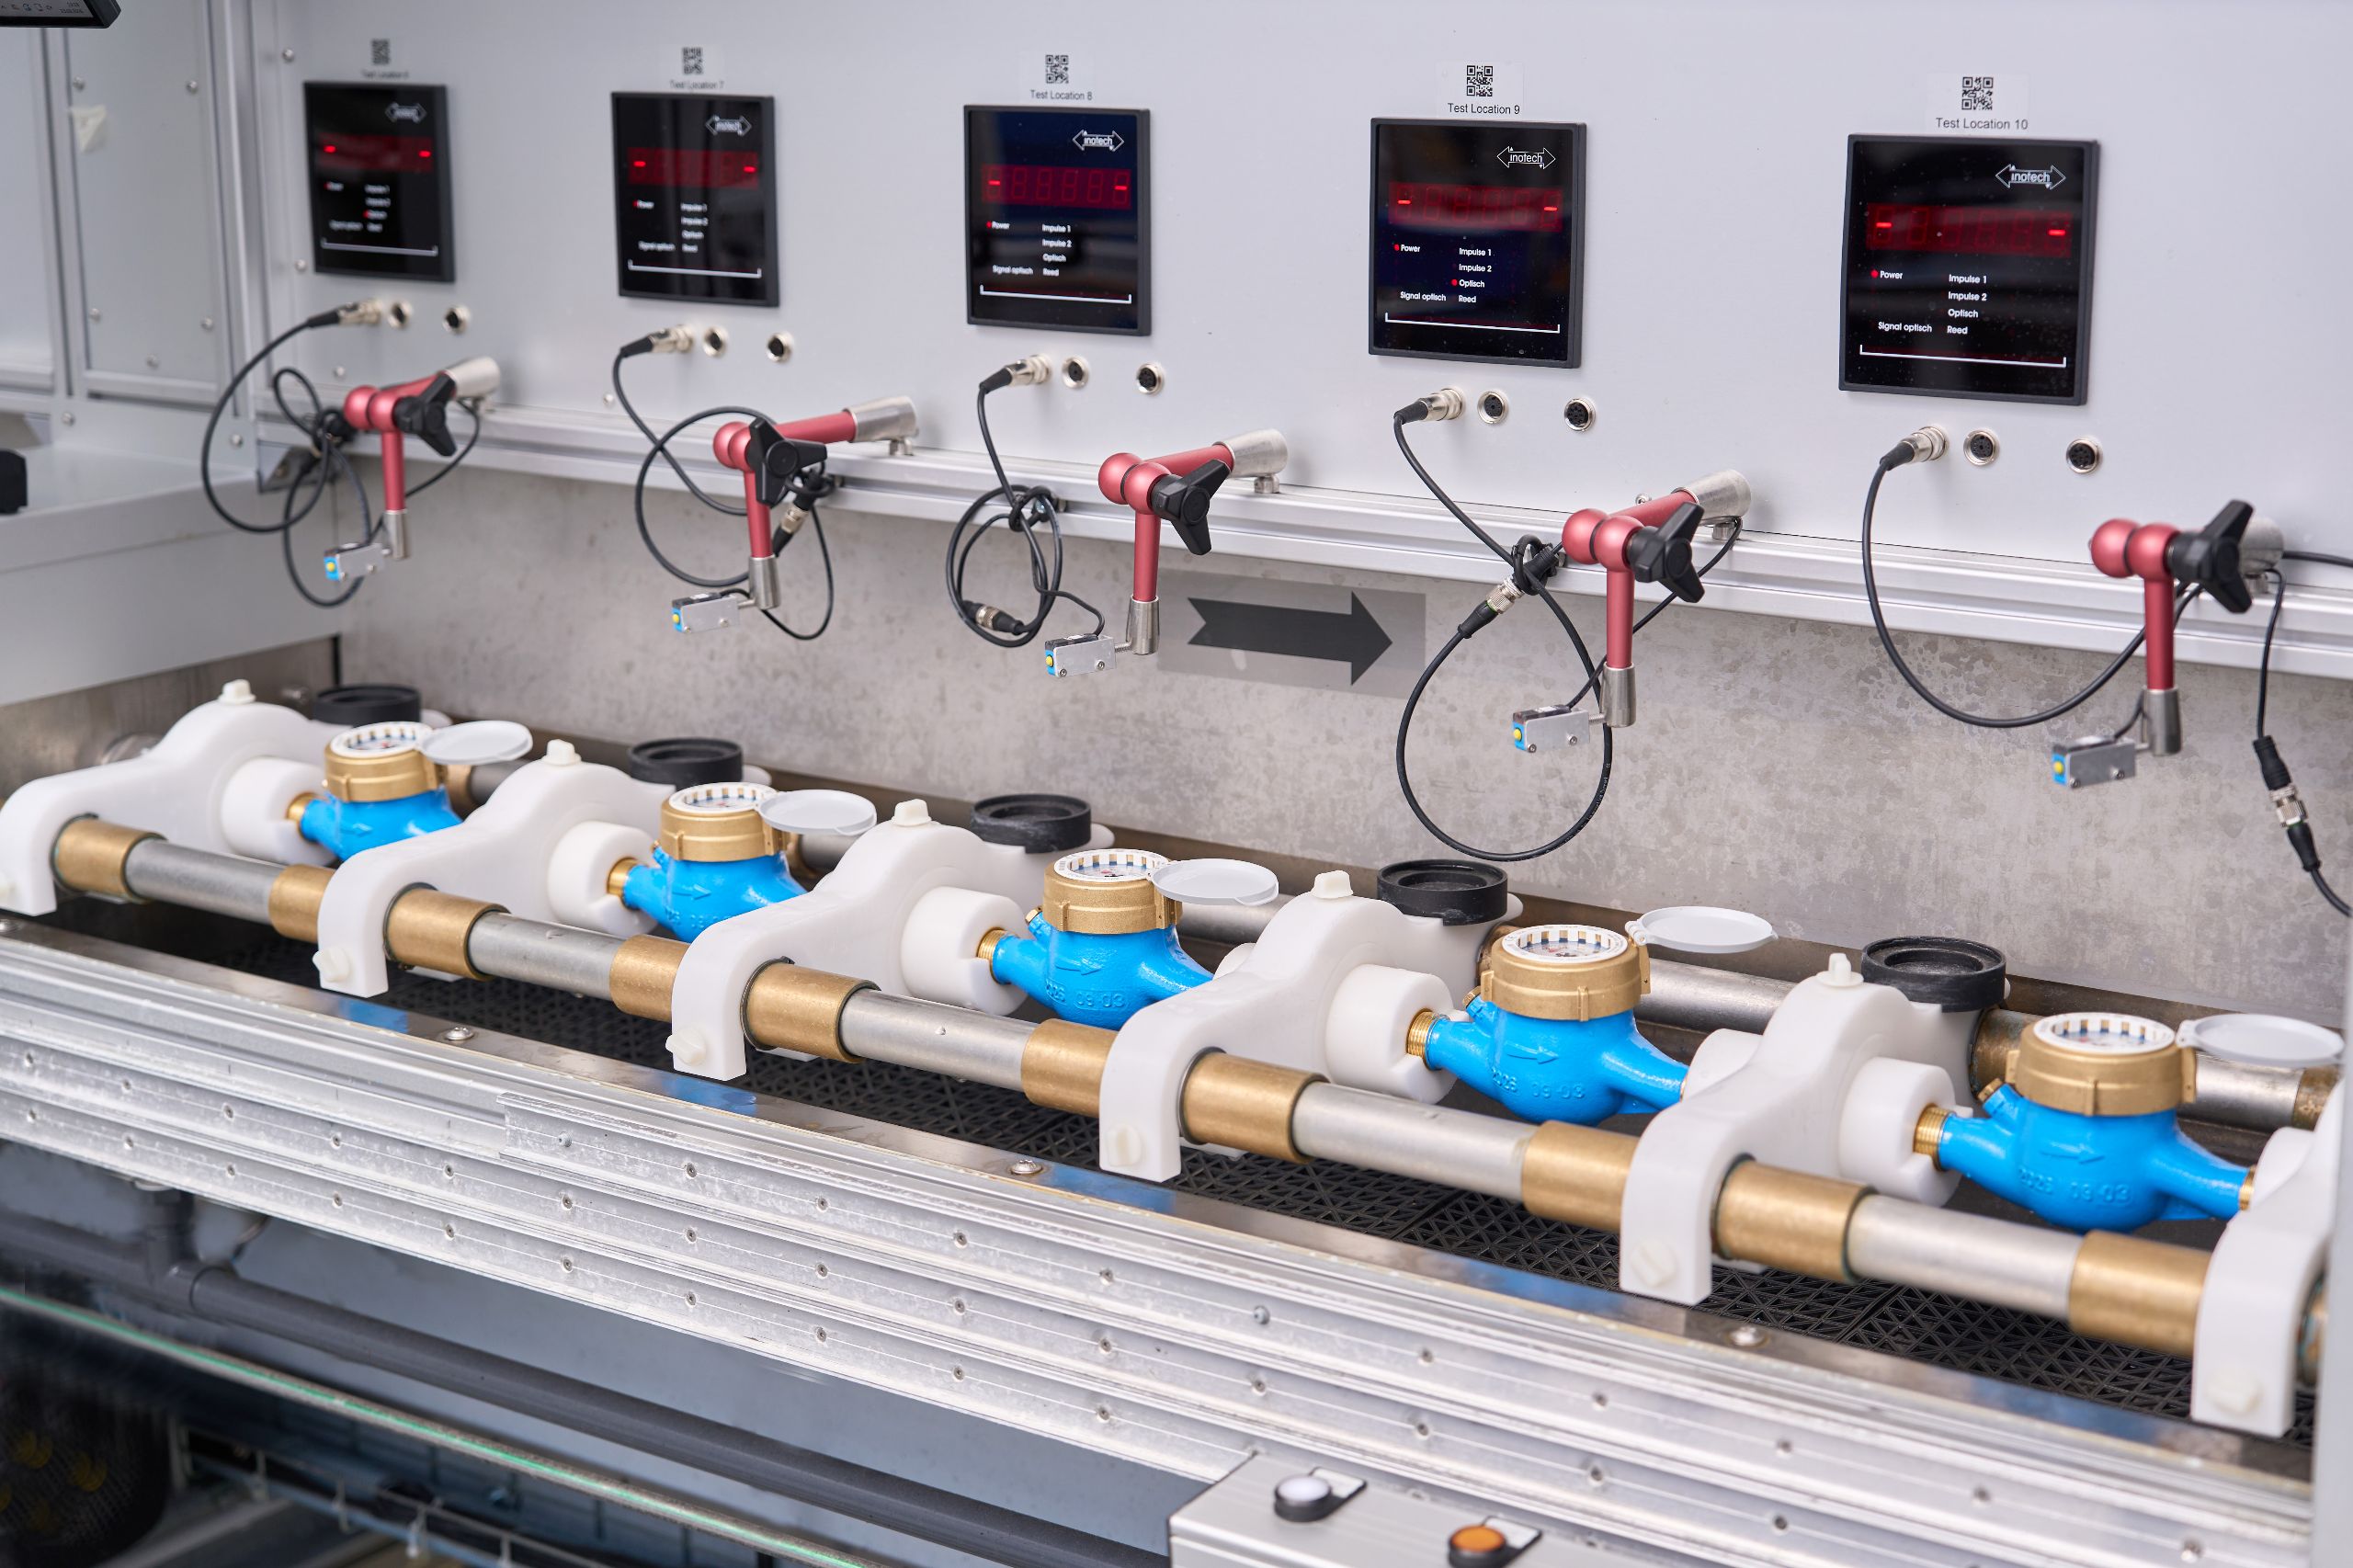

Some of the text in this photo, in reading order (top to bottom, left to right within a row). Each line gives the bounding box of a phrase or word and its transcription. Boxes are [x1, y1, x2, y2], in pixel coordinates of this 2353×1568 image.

[1030, 89, 1093, 101] Test Location 8
[1448, 103, 1520, 115] Test Location 9
[1936, 117, 2029, 130] Test Location 10
[1509, 153, 1543, 163] inotech
[2010, 172, 2051, 183] inotech
[1401, 244, 1421, 253] Power
[1459, 247, 1492, 257] Impulse 1
[1459, 263, 1493, 273] Impulse 2
[1880, 270, 1904, 279] Power
[1949, 274, 1987, 284] Impulse 1
[1459, 278, 1485, 289] Optisch
[1400, 290, 1447, 301] Signal optisch
[1458, 294, 1477, 303] Reed
[1948, 290, 1987, 301] Impulse 2
[1948, 308, 1979, 319] Optisch
[1878, 321, 1933, 333] Signal optisch
[1947, 325, 1969, 335] Reed
